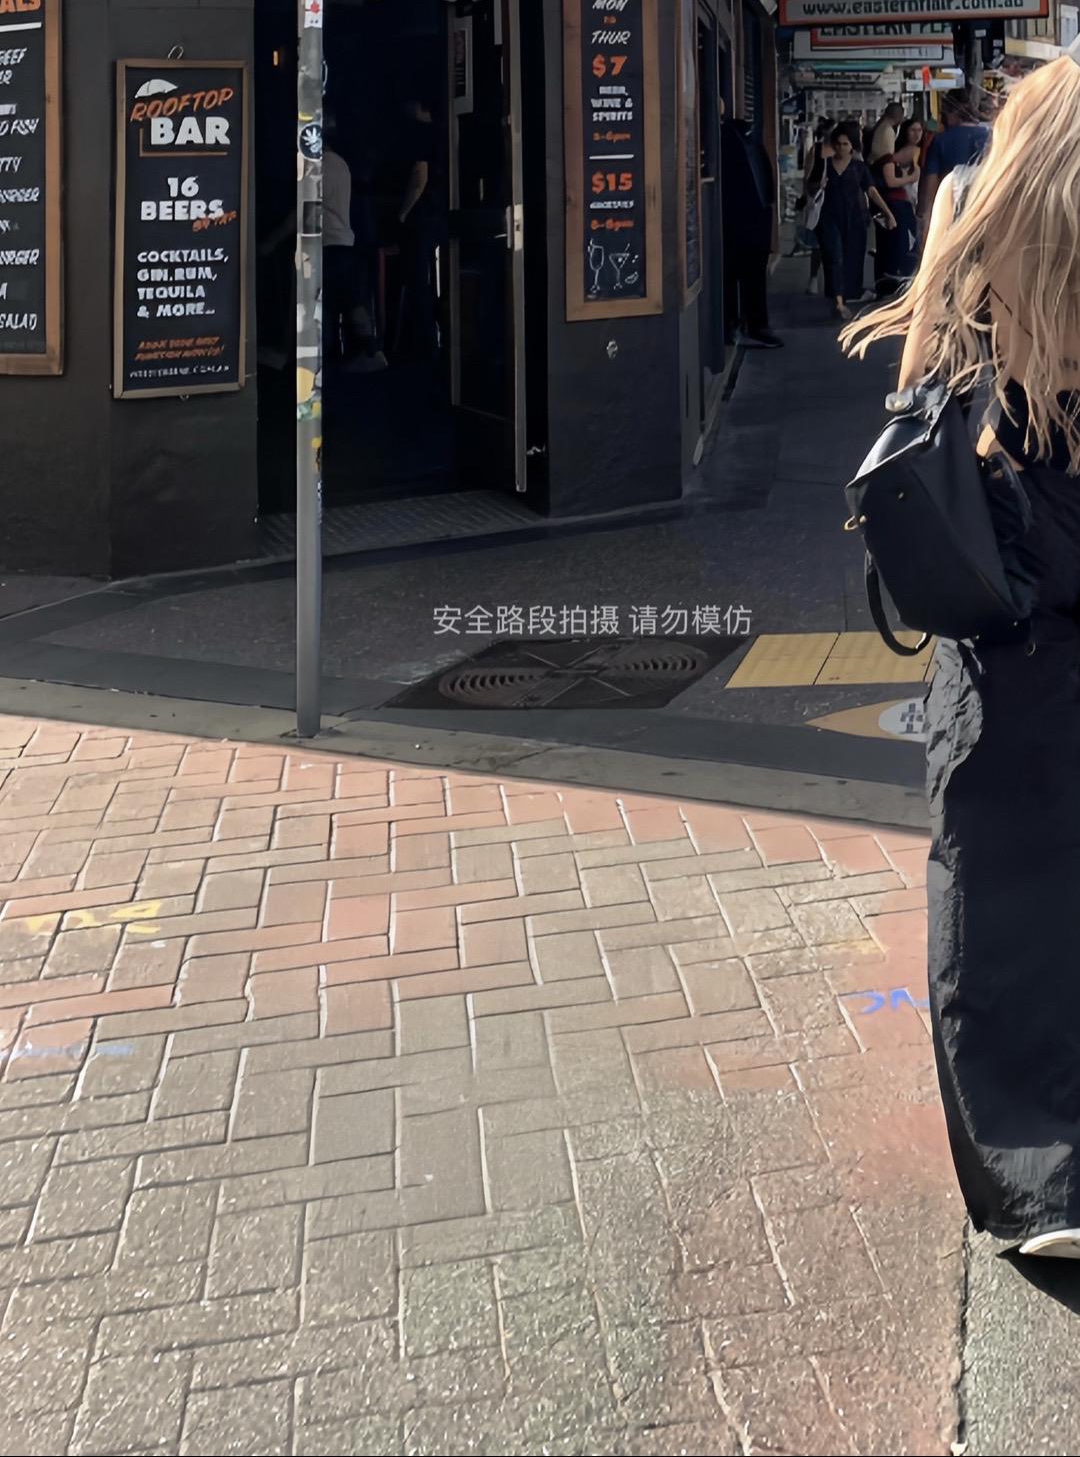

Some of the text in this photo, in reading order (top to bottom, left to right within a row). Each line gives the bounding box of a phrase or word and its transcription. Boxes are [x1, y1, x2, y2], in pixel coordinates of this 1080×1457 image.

[591, 30, 631, 45] THUR
[592, 54, 628, 79] $7
[130, 87, 234, 122] ROOFTOP
[150, 116, 231, 146] BAR
[167, 175, 200, 198] 16
[591, 171, 633, 195] $15
[140, 199, 225, 221] BEERS
[137, 248, 229, 263] COCKTAILS,
[137, 285, 206, 300] TEQUILA
[137, 305, 150, 319] &
